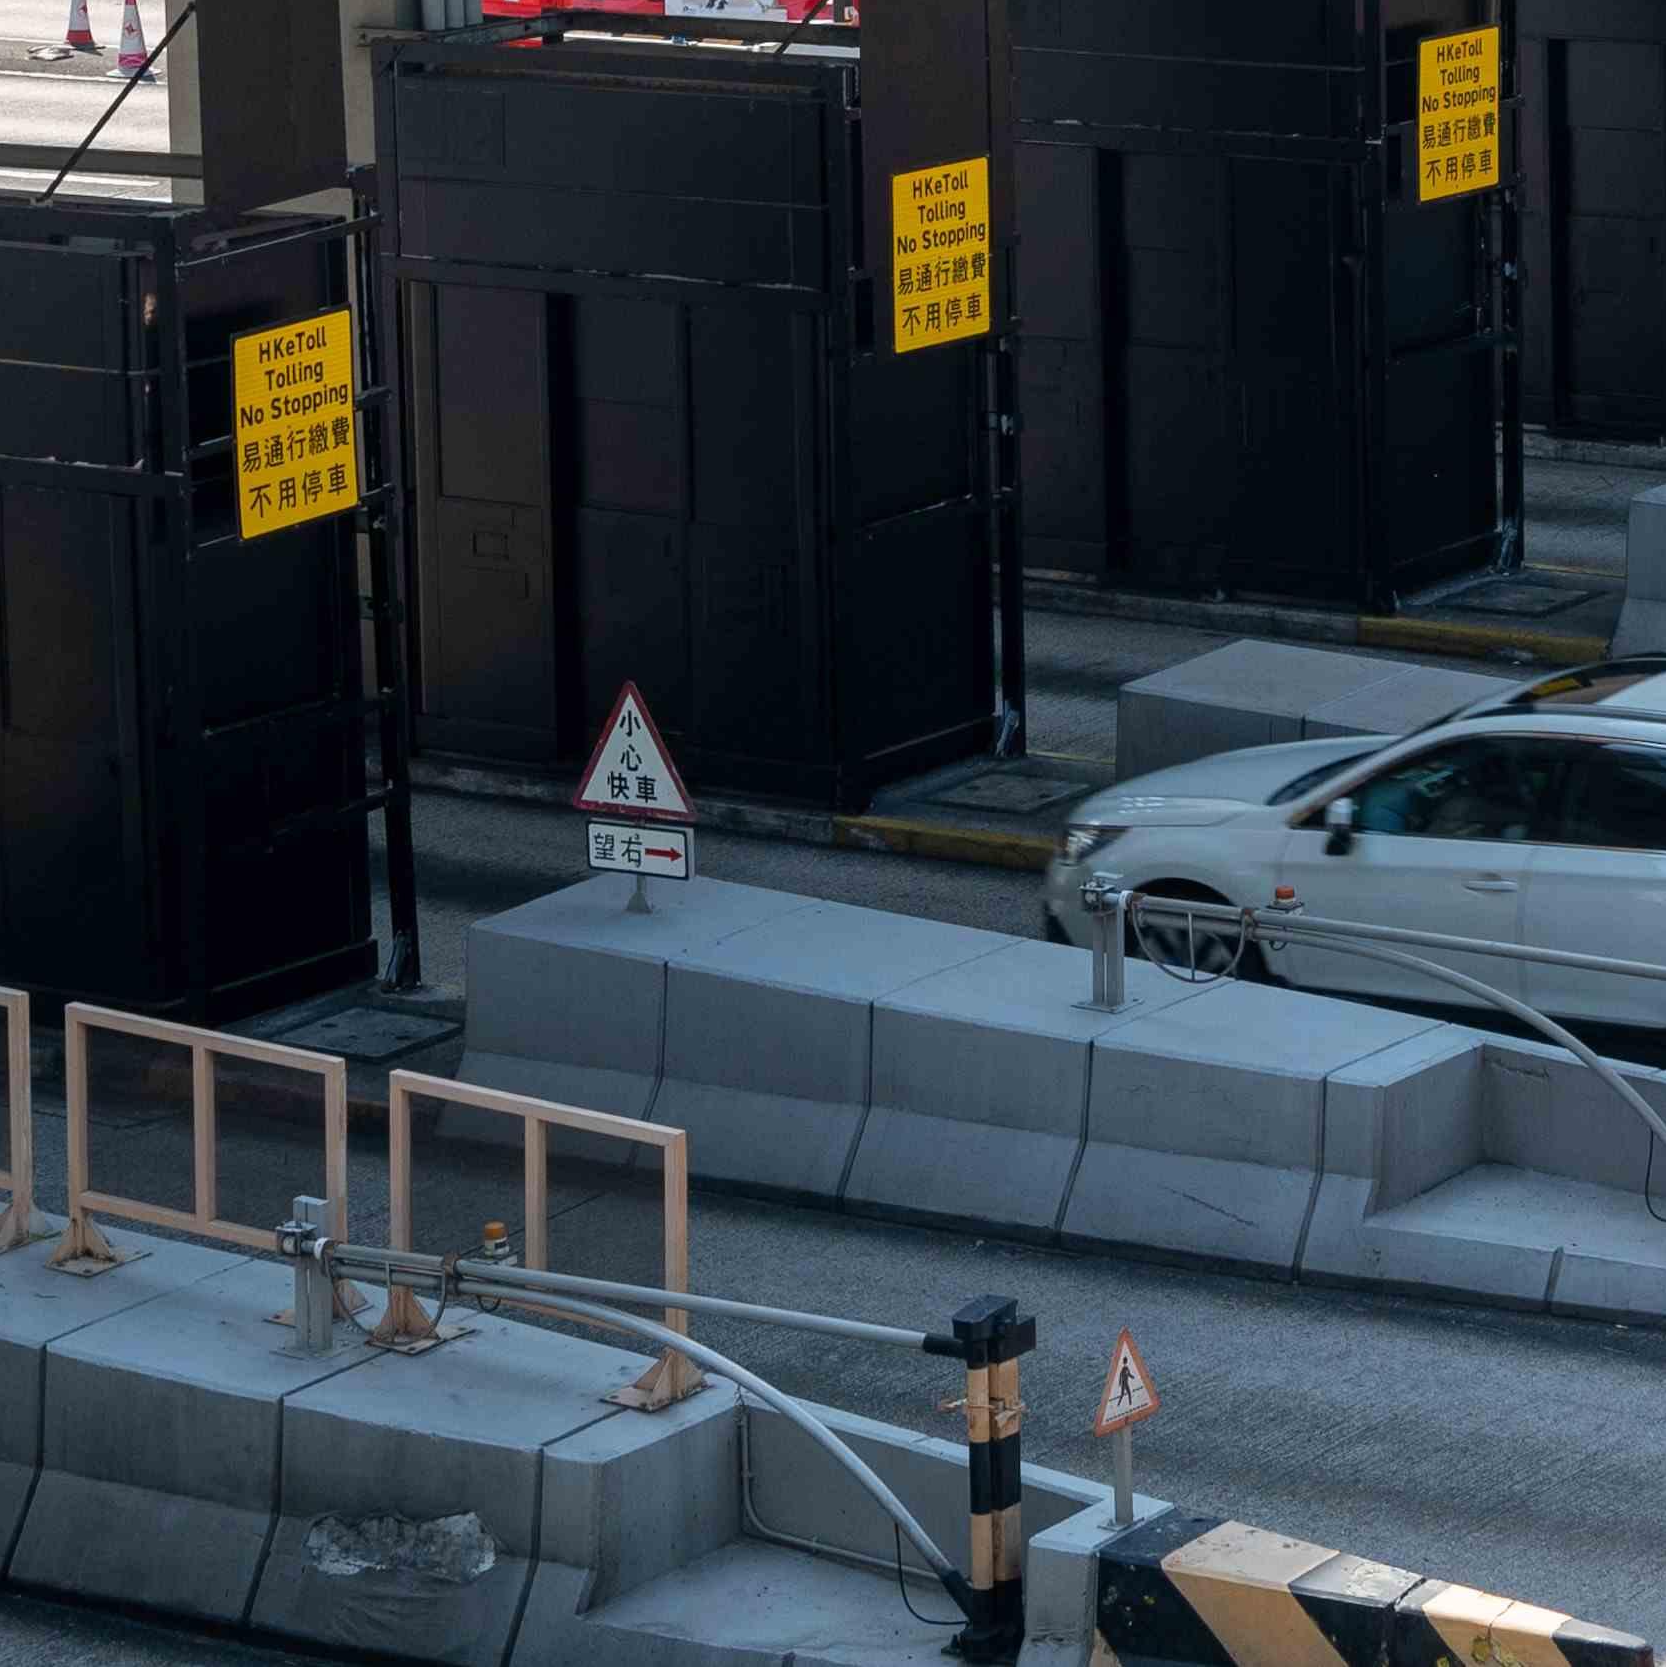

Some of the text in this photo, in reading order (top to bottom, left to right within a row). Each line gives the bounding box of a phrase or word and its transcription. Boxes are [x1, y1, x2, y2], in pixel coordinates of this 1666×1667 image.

[1437, 38, 1482, 63] HKeToll
[1440, 65, 1480, 86] Tolling
[1422, 85, 1496, 113] No Stopping
[1423, 112, 1495, 149] 易通行繳費
[913, 169, 968, 200] HKeToll
[1426, 148, 1492, 187] 不用停車
[918, 201, 966, 224] Tolling
[897, 223, 986, 255] No Stopping
[898, 252, 986, 295] 易通行繳費
[902, 293, 982, 335] 不用停車
[259, 326, 327, 364] HKeToll
[265, 361, 324, 391] Tolling
[240, 384, 348, 428] No Stopping
[243, 416, 350, 473] 易通行繳費
[249, 463, 348, 518] 不用停車
[607, 770, 658, 803] 快車
[593, 832, 643, 868] 望右
